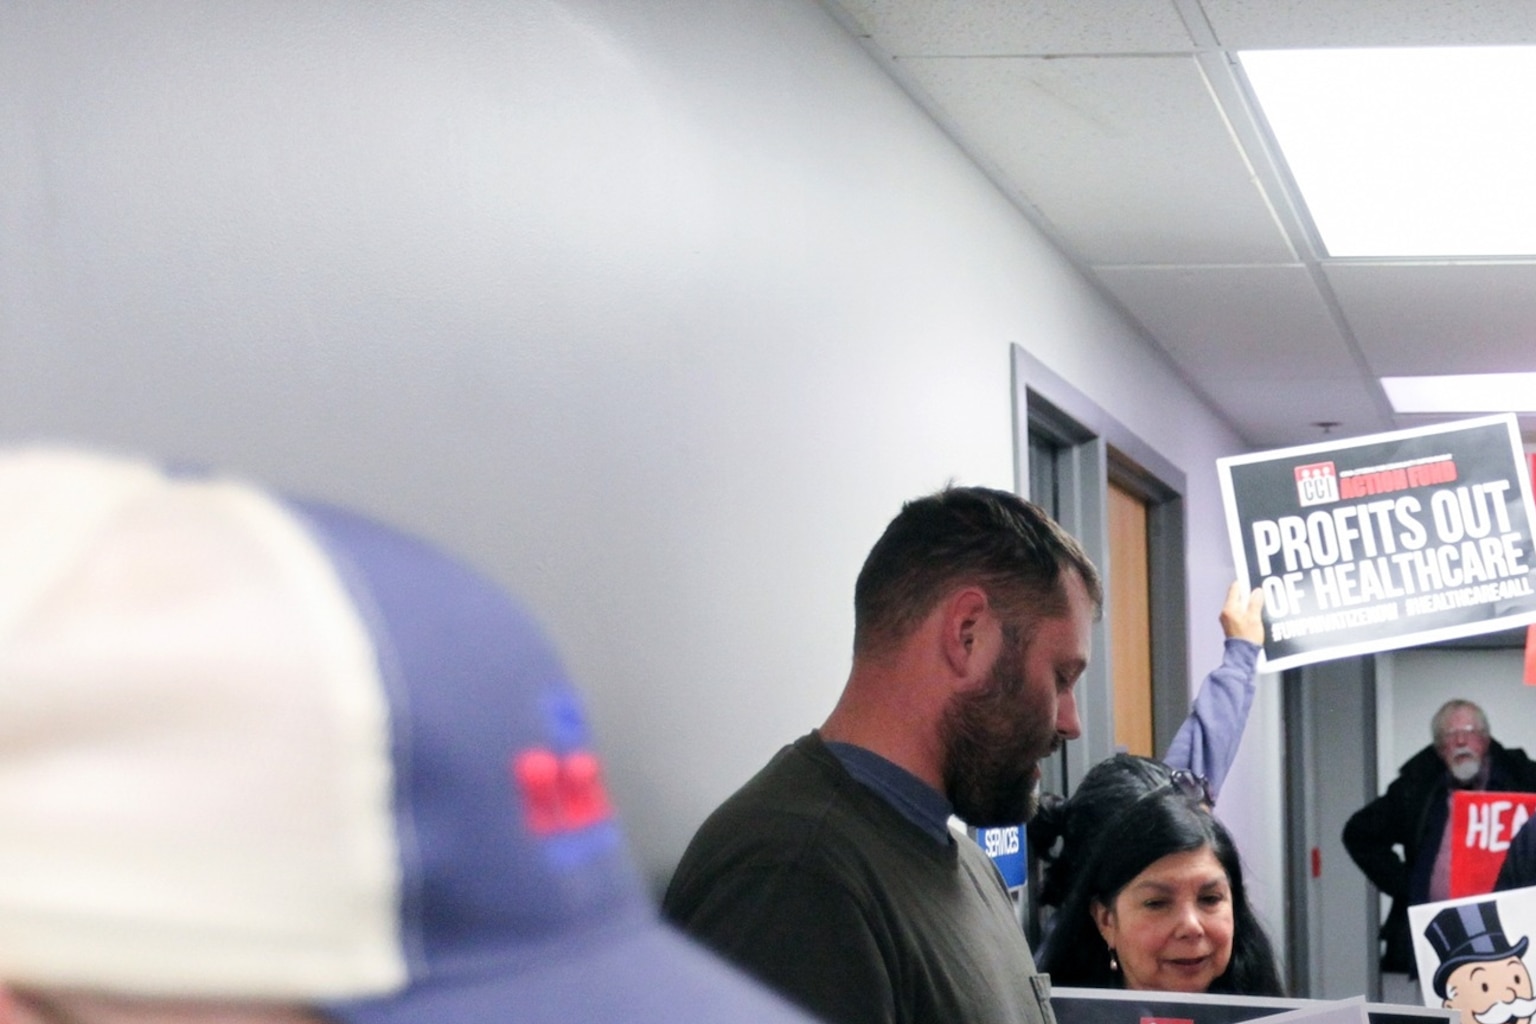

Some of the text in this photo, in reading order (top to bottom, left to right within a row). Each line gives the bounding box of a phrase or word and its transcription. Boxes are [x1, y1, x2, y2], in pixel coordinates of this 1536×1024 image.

[1252, 480, 1512, 576] PROFITS OUT
[1302, 478, 1333, 501] CCI
[1262, 533, 1530, 619] OF HEALTHCARE
